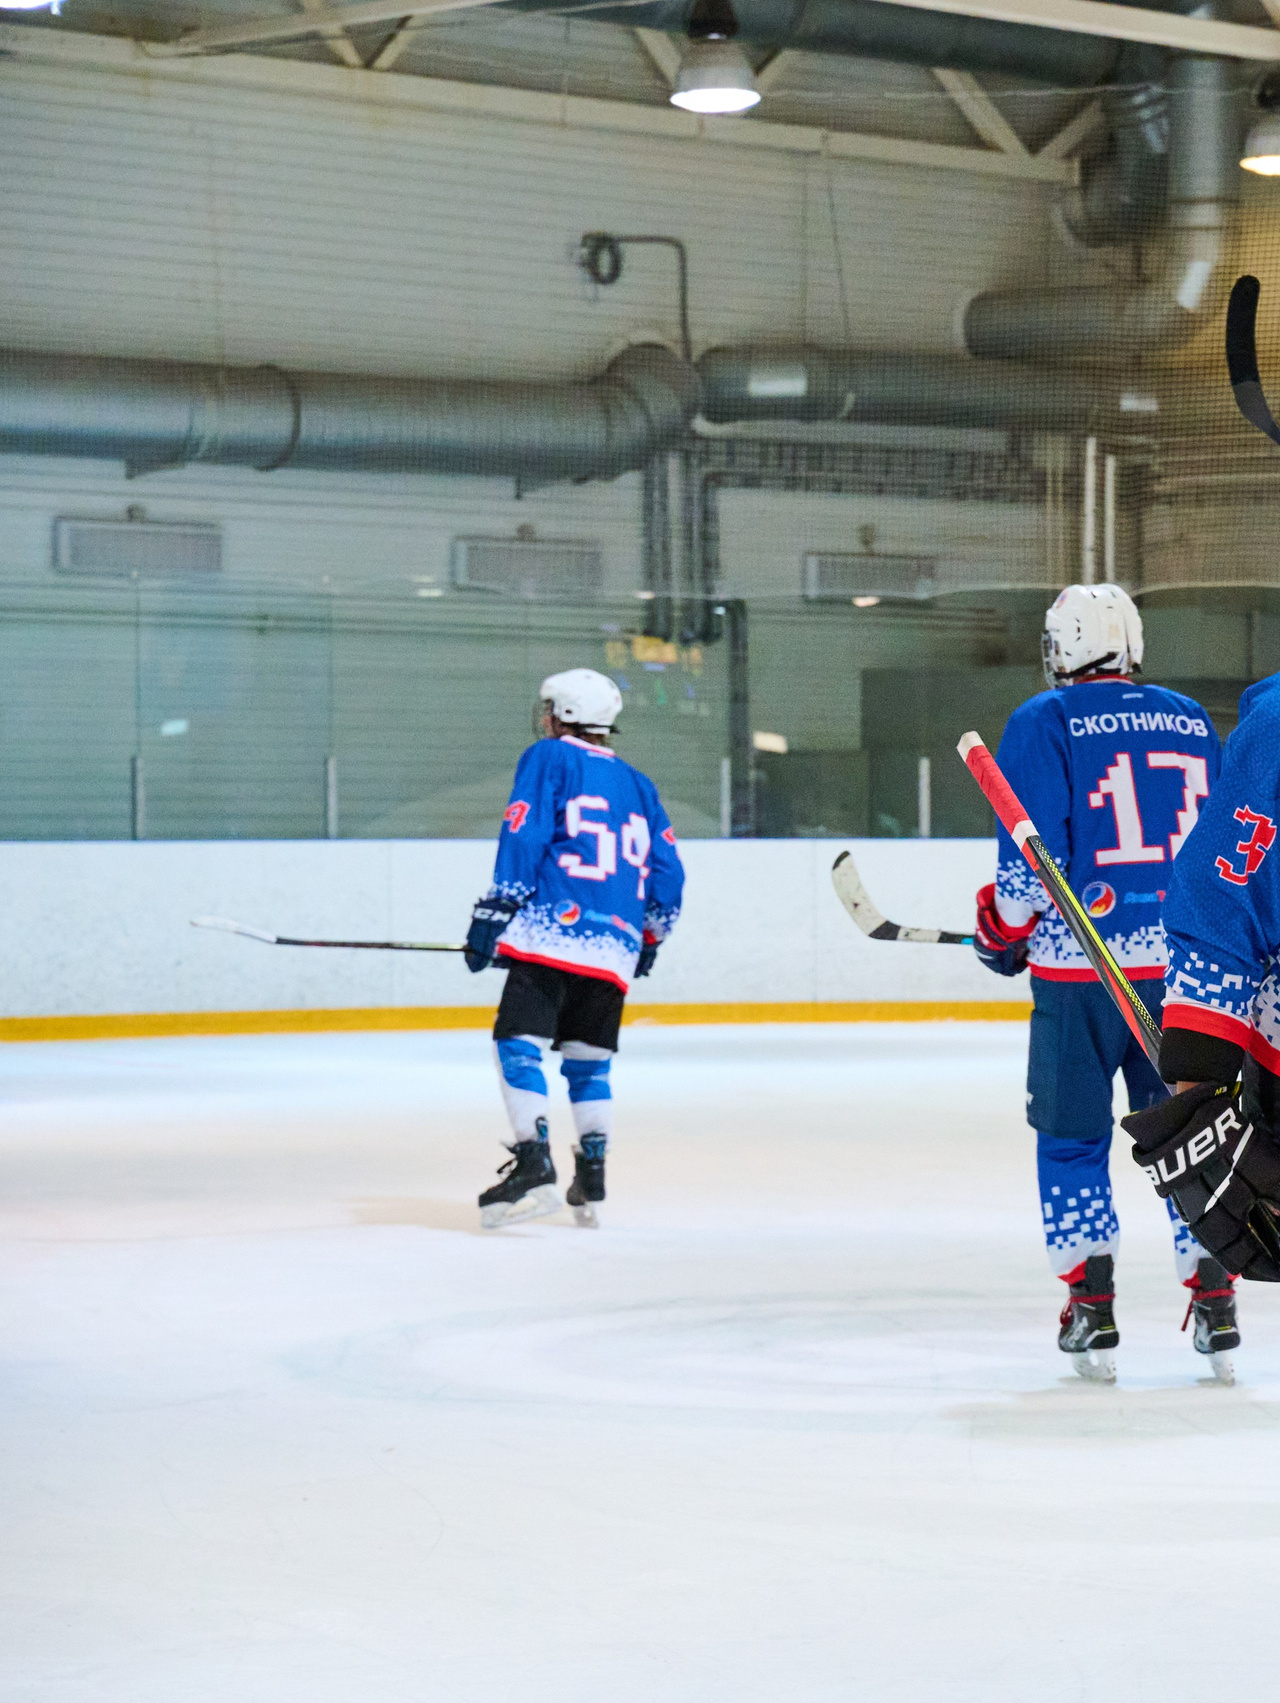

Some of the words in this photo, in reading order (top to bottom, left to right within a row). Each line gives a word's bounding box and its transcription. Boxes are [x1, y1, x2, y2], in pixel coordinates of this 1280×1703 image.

[1069, 710, 1209, 738] СКОТНИКОВ
[557, 794, 653, 901] 54
[1088, 750, 1210, 867] 17
[1214, 803, 1278, 887] 3
